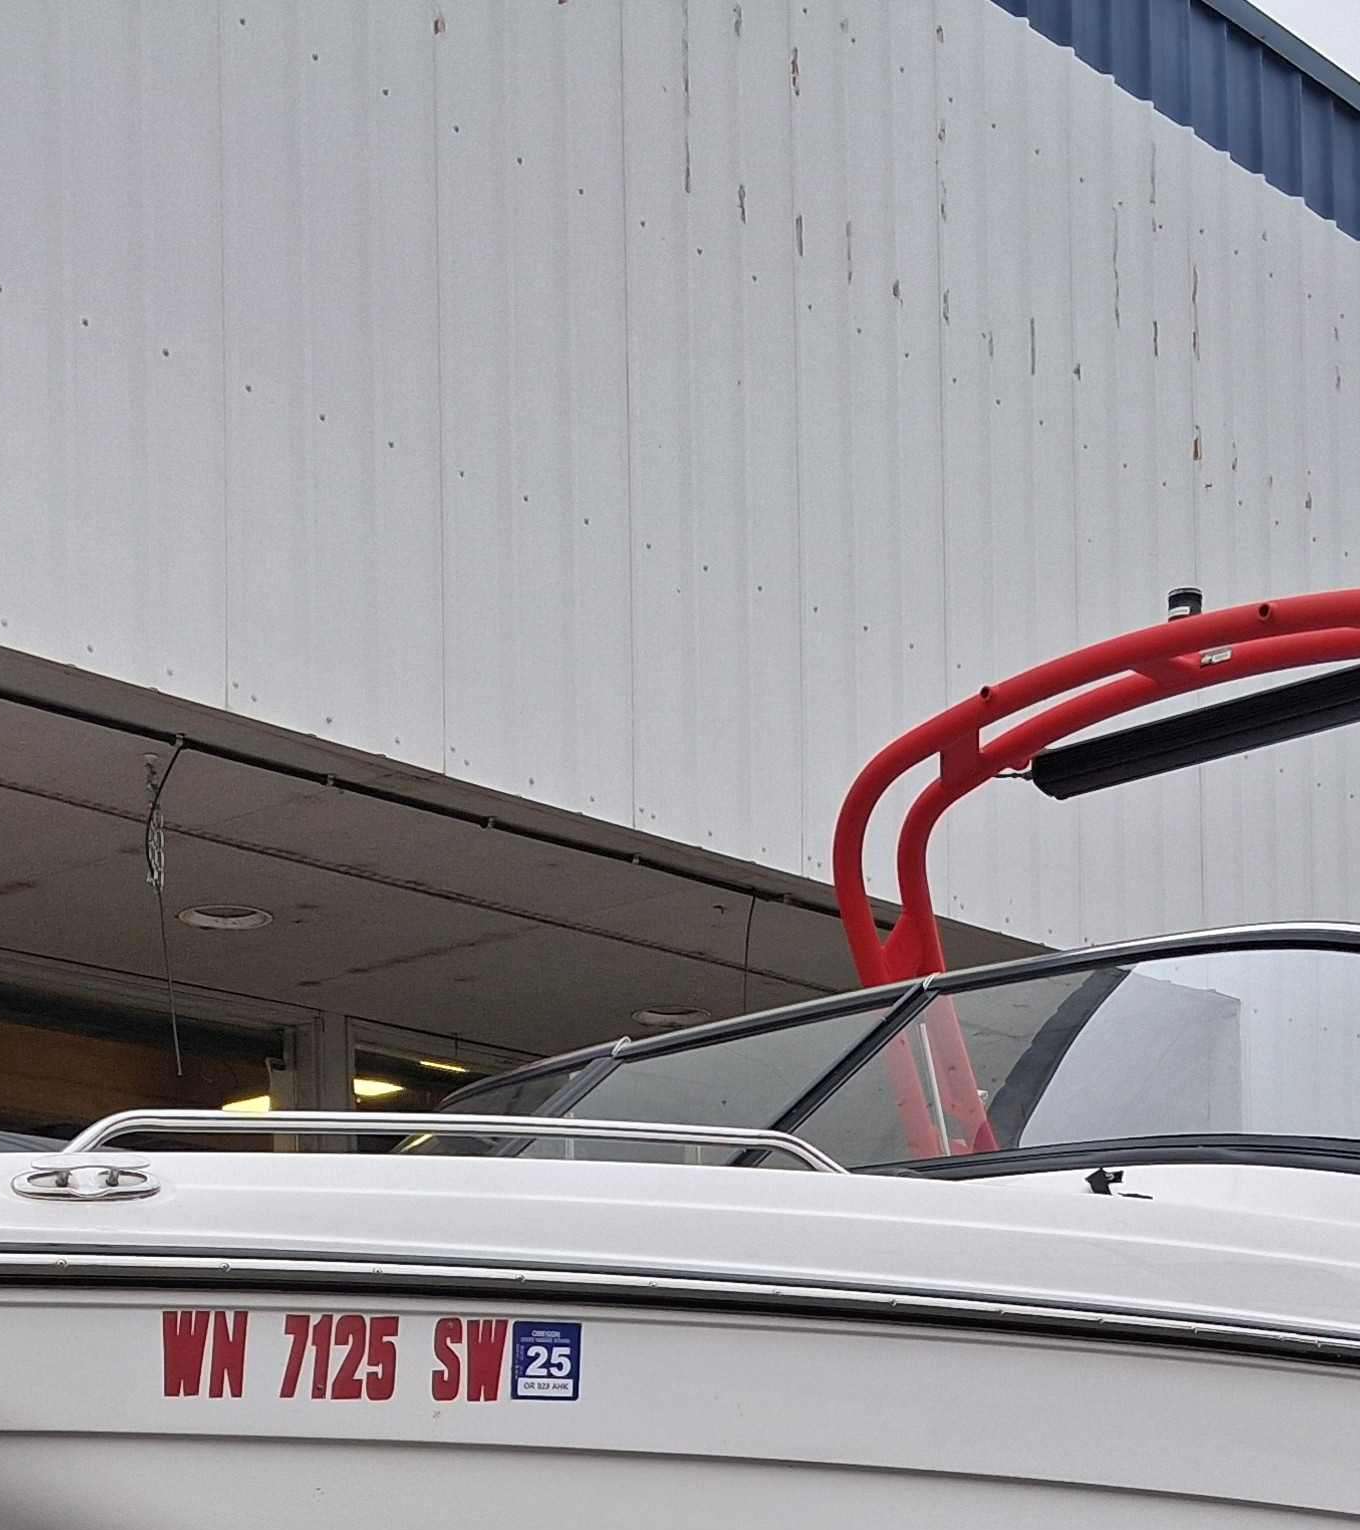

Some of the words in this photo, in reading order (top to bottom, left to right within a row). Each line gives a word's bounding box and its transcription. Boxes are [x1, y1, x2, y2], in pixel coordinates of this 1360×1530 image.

[162, 1310, 249, 1399] WN
[278, 1313, 400, 1401] 7125
[431, 1316, 510, 1402] SW
[525, 1345, 572, 1377] 25
